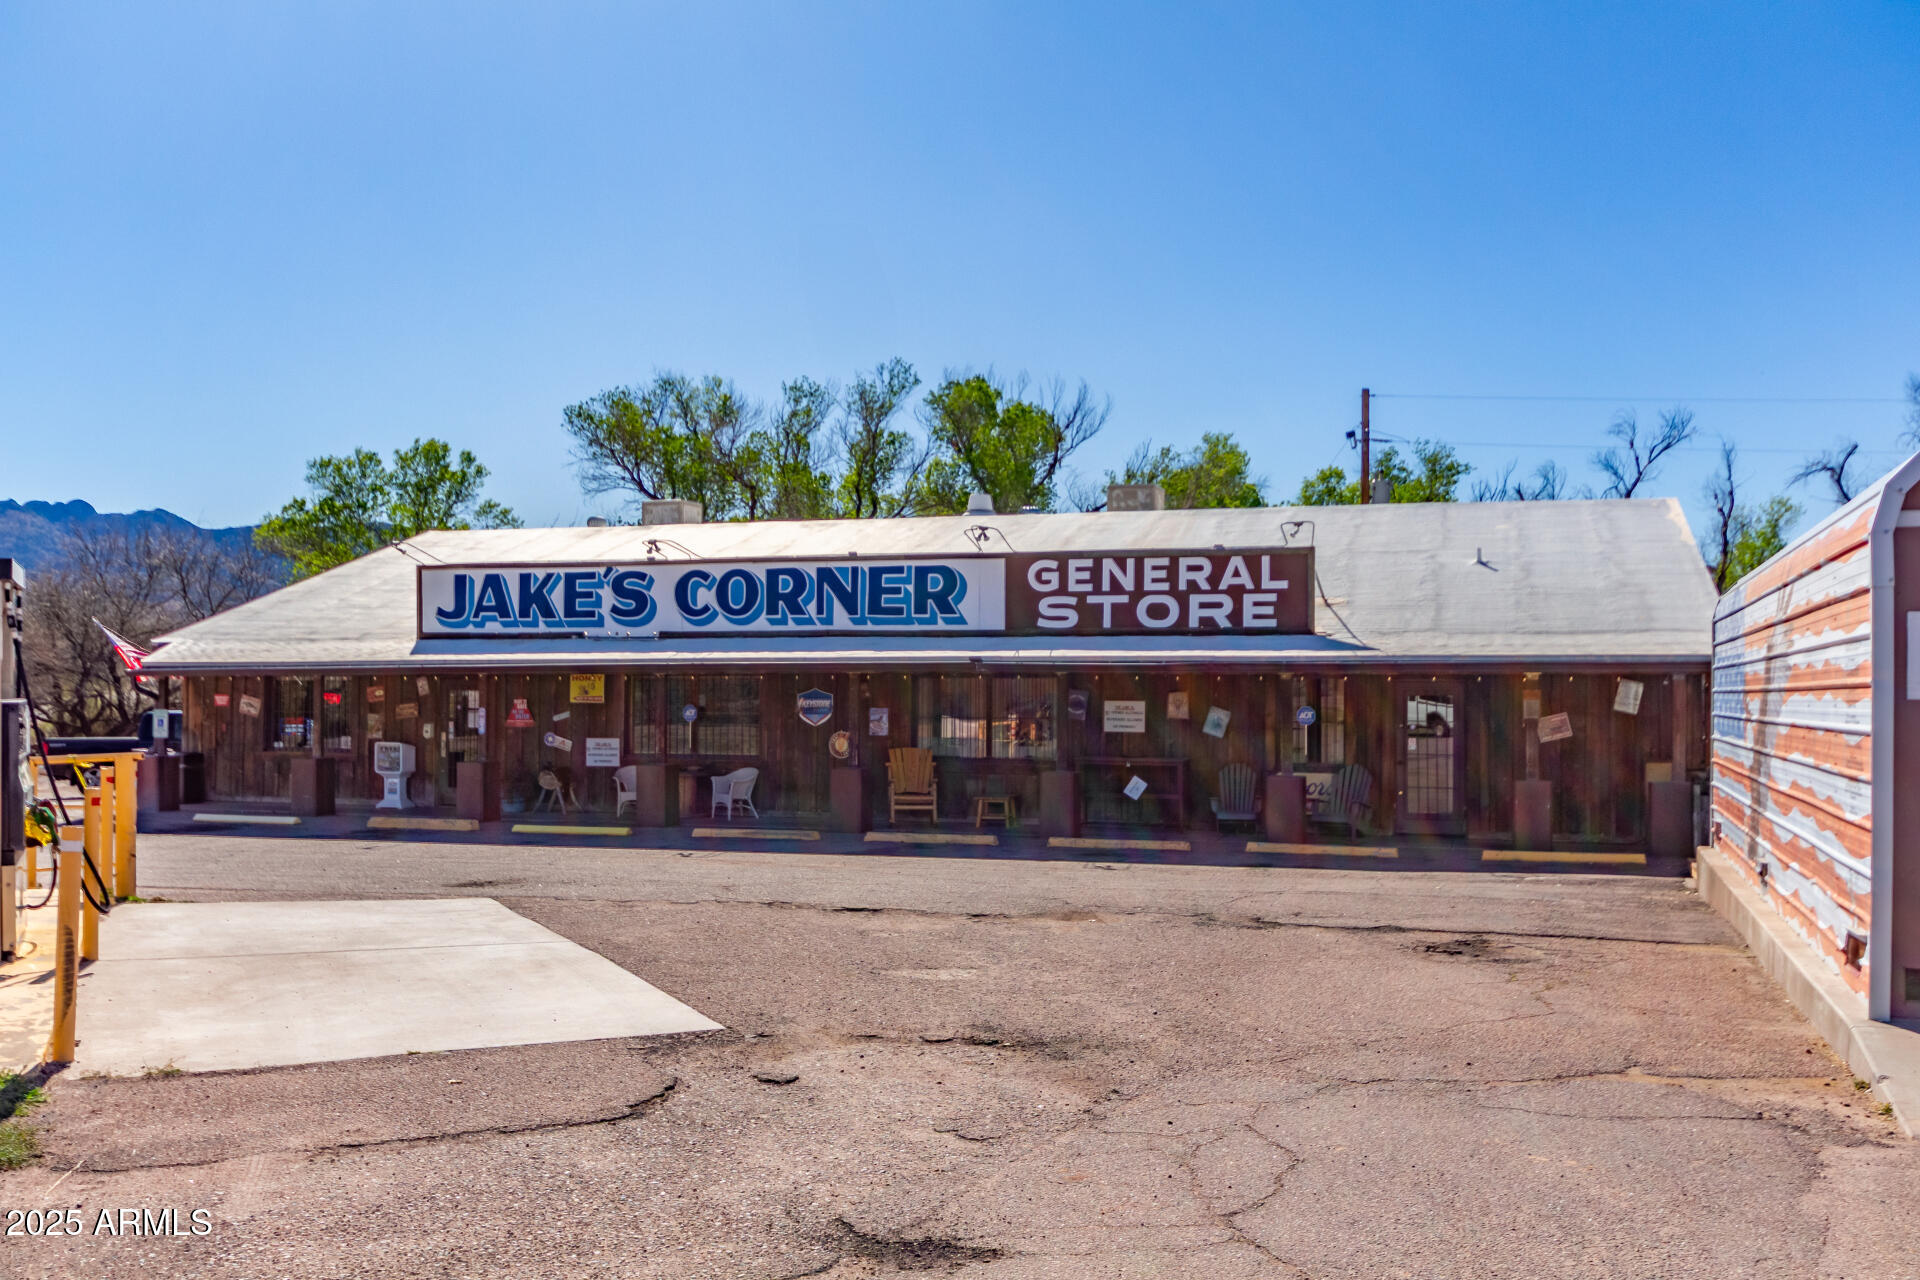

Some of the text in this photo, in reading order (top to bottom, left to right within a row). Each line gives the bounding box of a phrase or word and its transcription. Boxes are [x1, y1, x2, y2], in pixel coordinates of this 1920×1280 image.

[1027, 554, 1289, 592] GENERAL
[435, 564, 969, 629] JAKE'S CORNER
[1037, 592, 1278, 629] STORE
